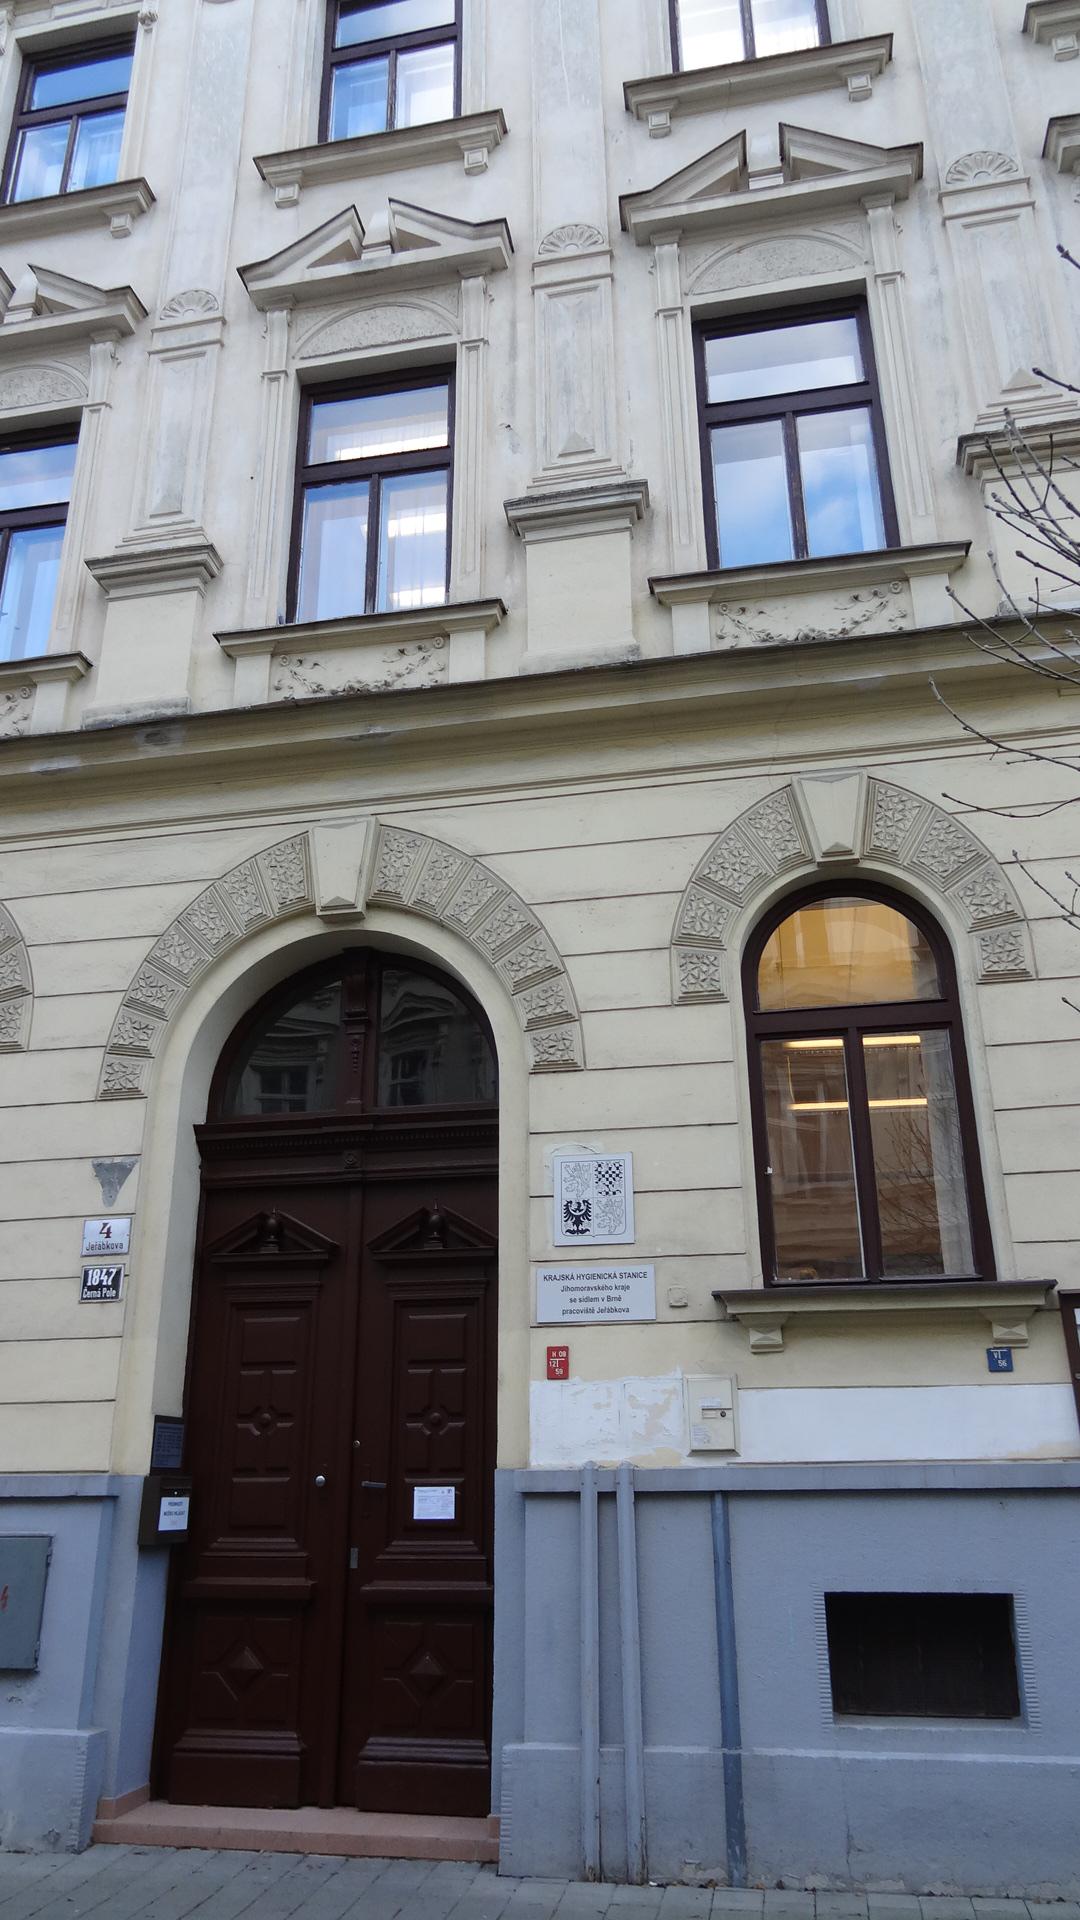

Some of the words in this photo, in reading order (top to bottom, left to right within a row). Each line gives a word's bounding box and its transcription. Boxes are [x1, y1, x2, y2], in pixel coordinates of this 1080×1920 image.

[99, 1222, 112, 1238] 4
[85, 1242, 123, 1251] Jeřábkova
[86, 1268, 117, 1286] 1847
[543, 1273, 575, 1281] KRAJSKÁ
[576, 1272, 617, 1280] HYGIENICKÁ
[83, 1287, 101, 1298] Černá
[102, 1288, 117, 1297] Pole
[614, 1284, 631, 1292] kraje
[578, 1295, 600, 1303] sídlem
[562, 1308, 595, 1316] pracoviště
[596, 1306, 630, 1314] Jeřábkova
